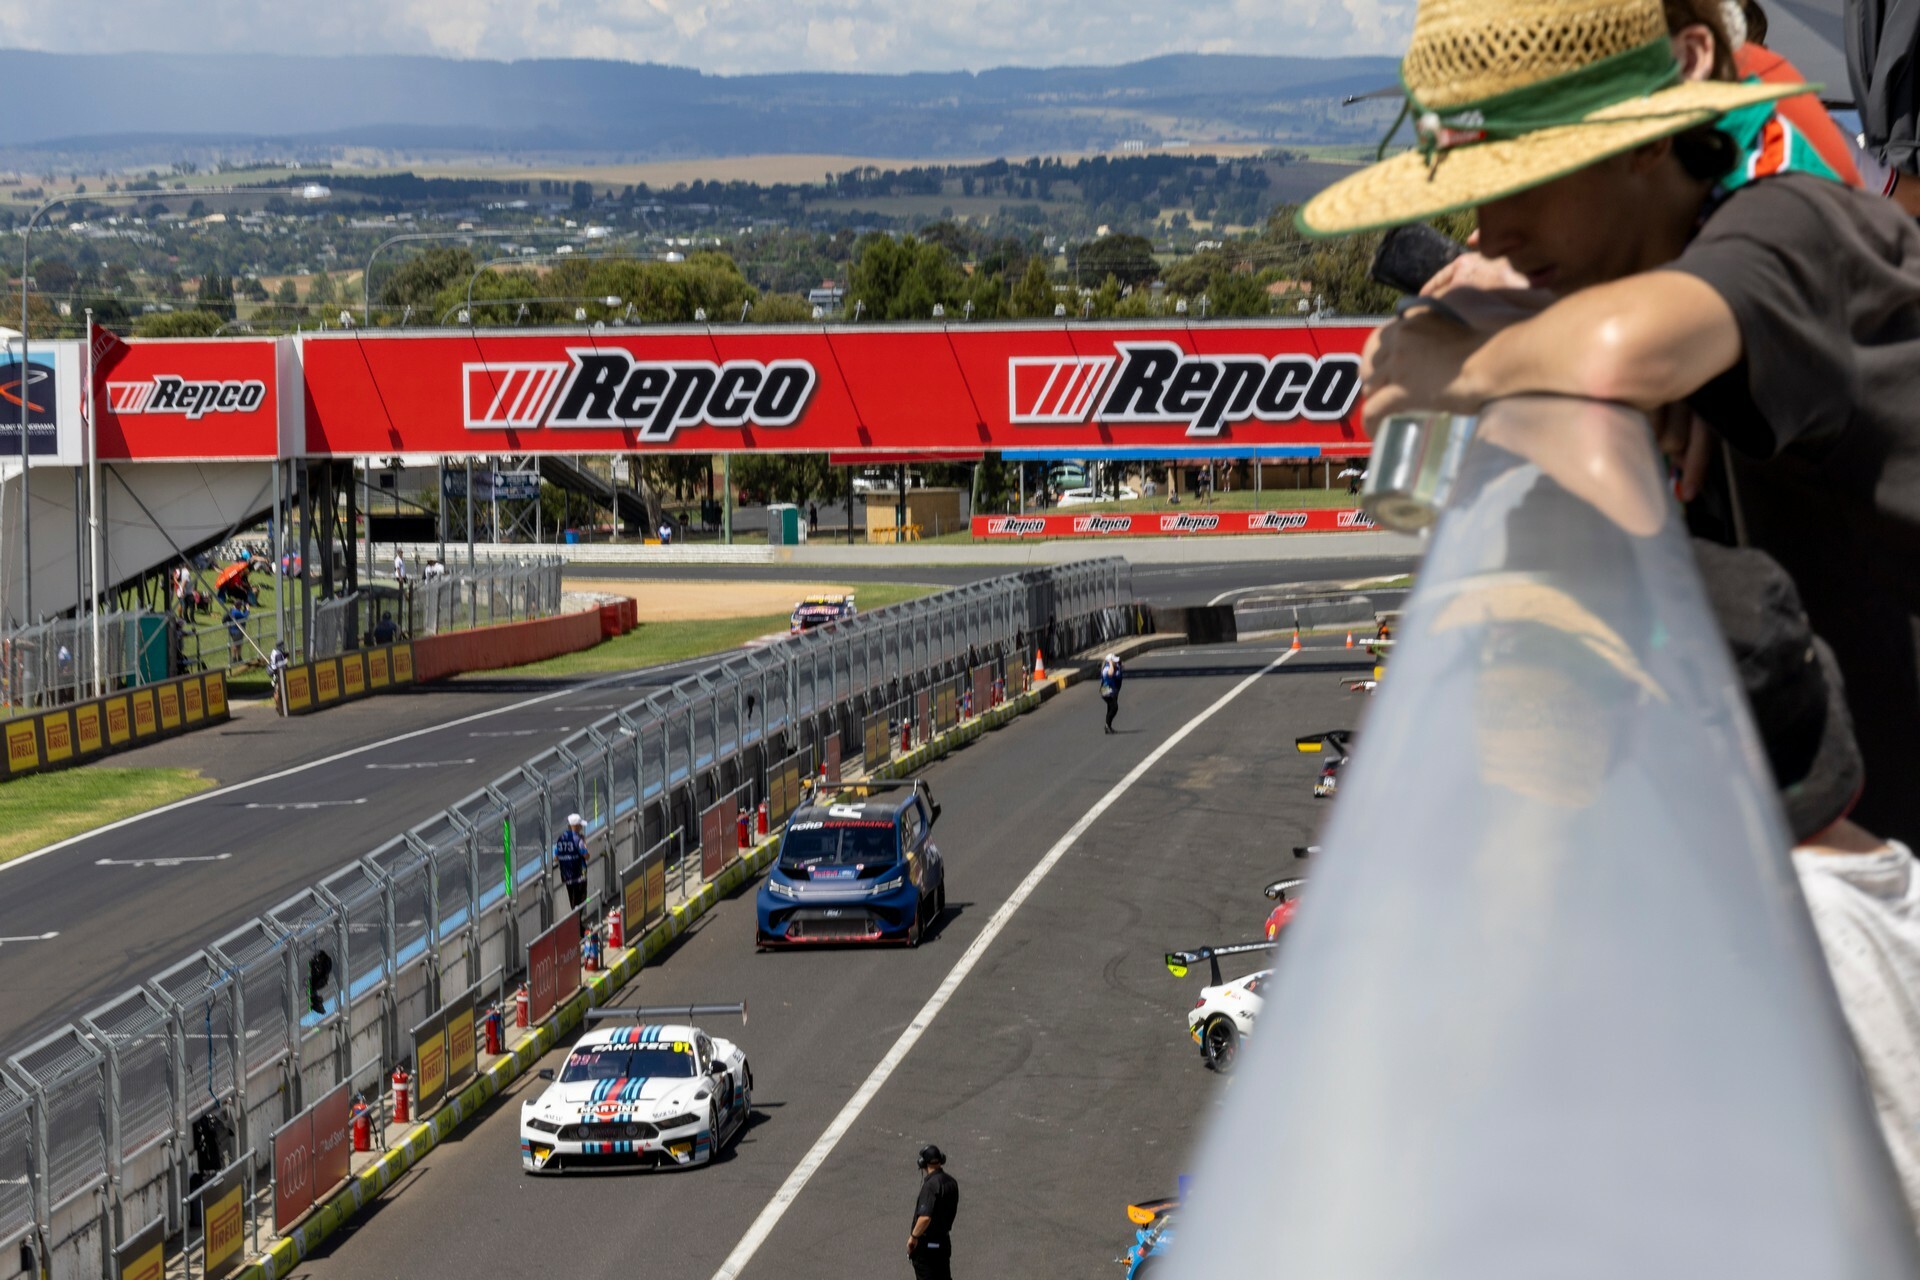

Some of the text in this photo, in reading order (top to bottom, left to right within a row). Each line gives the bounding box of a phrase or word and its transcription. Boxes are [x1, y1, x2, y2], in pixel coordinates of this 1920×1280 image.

[146, 375, 266, 419] Repco
[548, 348, 815, 441] Repco
[1095, 341, 1363, 436] Repco
[1003, 516, 1045, 535] Repco
[1089, 514, 1131, 533] Repco
[1176, 513, 1219, 532] Repco
[1264, 512, 1307, 530] Repco
[823, 820, 894, 829] PERFORMANCE
[451, 1022, 473, 1061] PIRELLI
[591, 1042, 671, 1053] FANATEC
[421, 1044, 443, 1086] PIRELLI
[580, 1104, 637, 1114] MARTINI
[210, 1201, 240, 1254] PIRELLI
